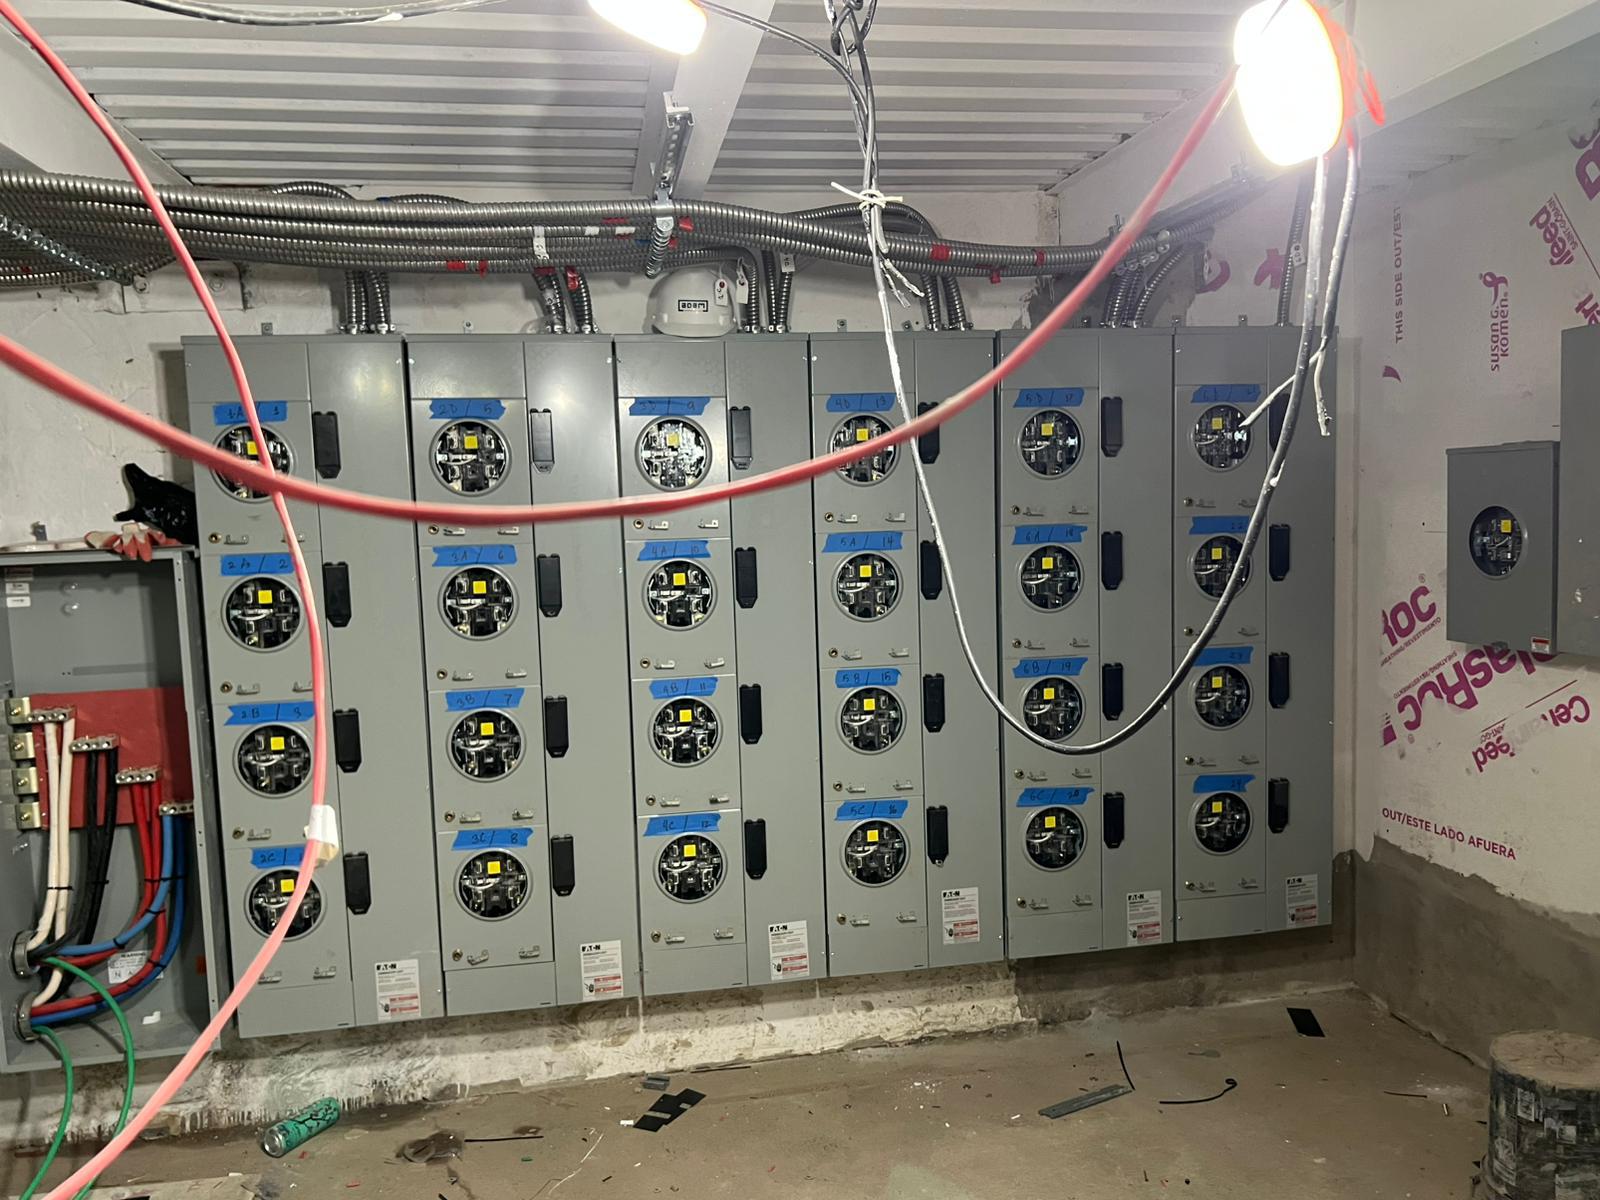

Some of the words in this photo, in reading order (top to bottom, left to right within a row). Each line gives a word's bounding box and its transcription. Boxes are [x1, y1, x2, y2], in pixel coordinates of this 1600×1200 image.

[1394, 272, 1402, 306] SIDE
[1395, 312, 1403, 344] THIS
[1382, 808, 1432, 832] OUT/ESTE
[1434, 824, 1465, 842] LADO
[1468, 836, 1516, 860] AFUERA
